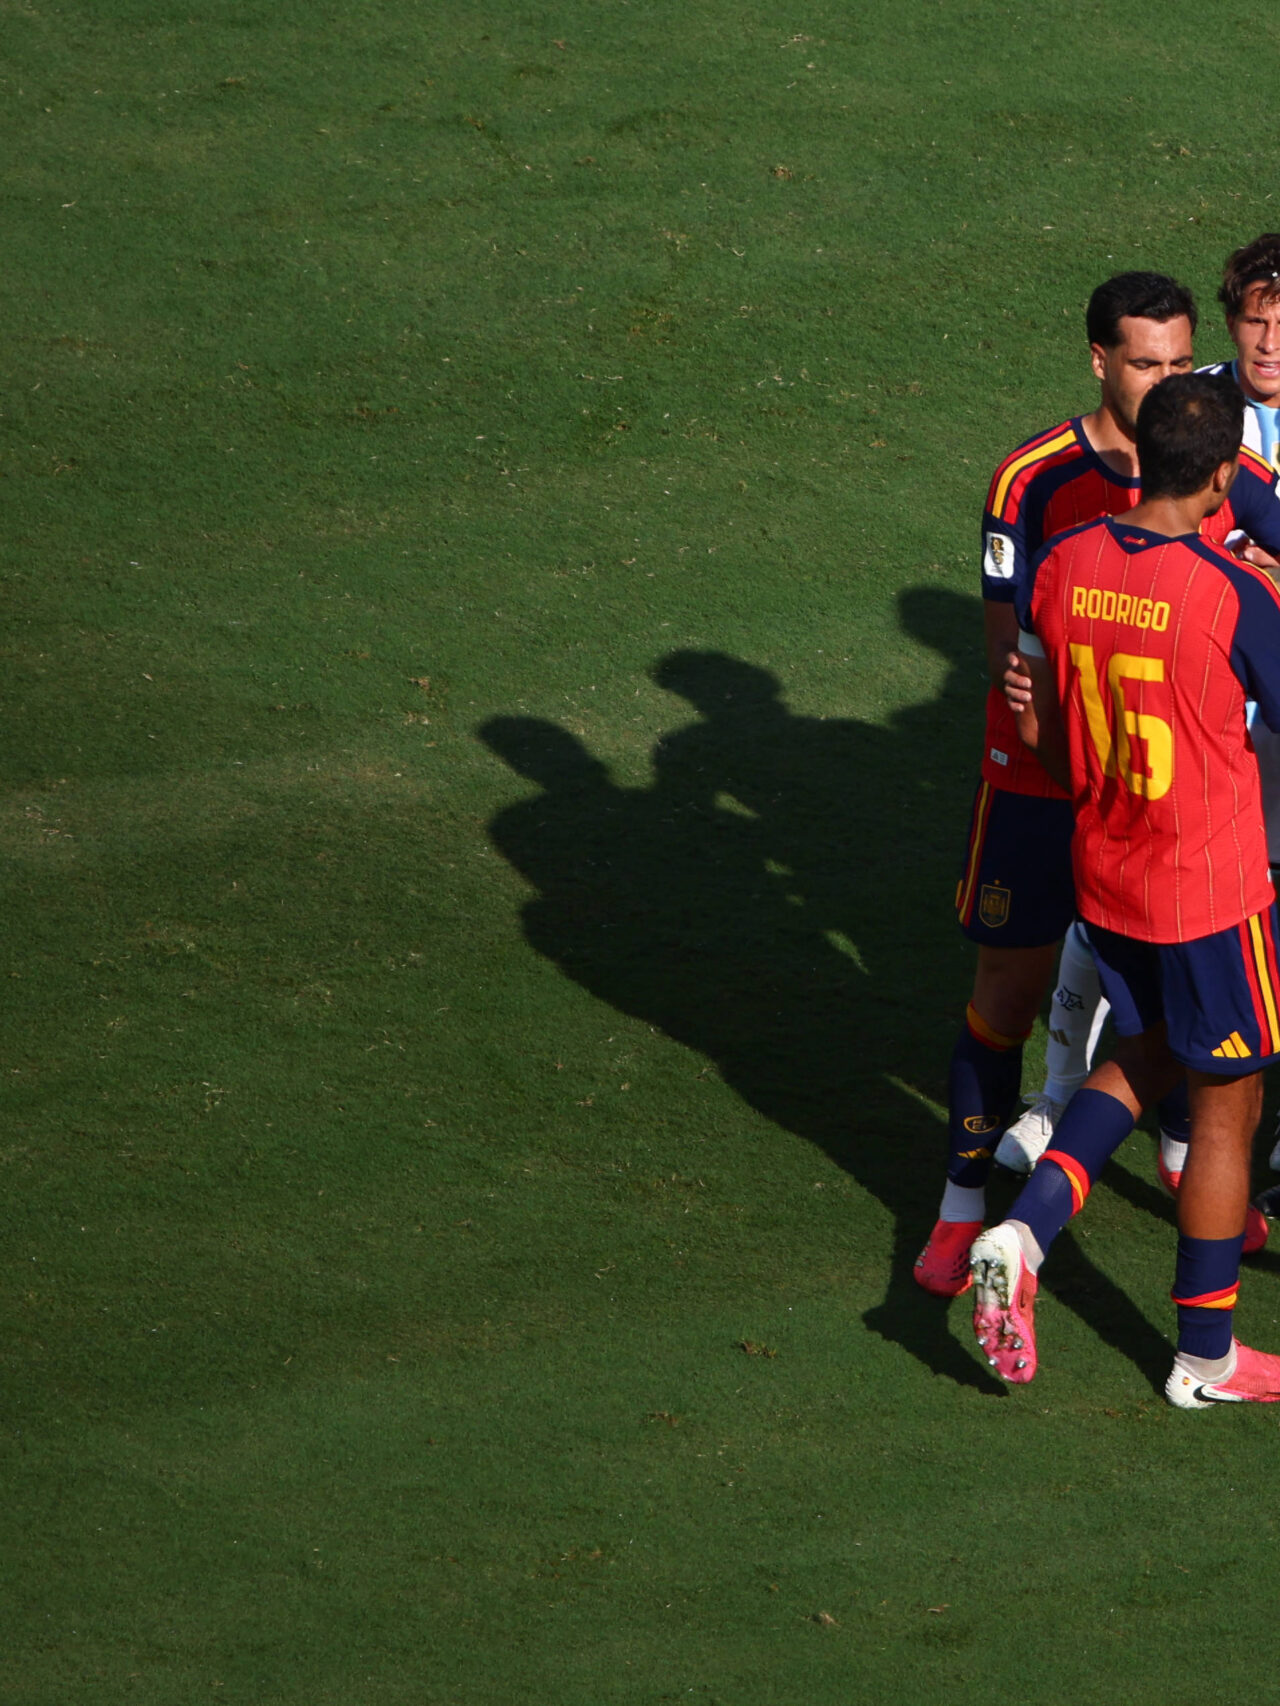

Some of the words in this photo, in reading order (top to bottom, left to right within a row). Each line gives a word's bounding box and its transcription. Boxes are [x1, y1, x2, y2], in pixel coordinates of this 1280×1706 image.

[1072, 586, 1170, 632] RODRIGO
[1069, 642, 1173, 801] 16
[1057, 986, 1085, 1011] AFA
